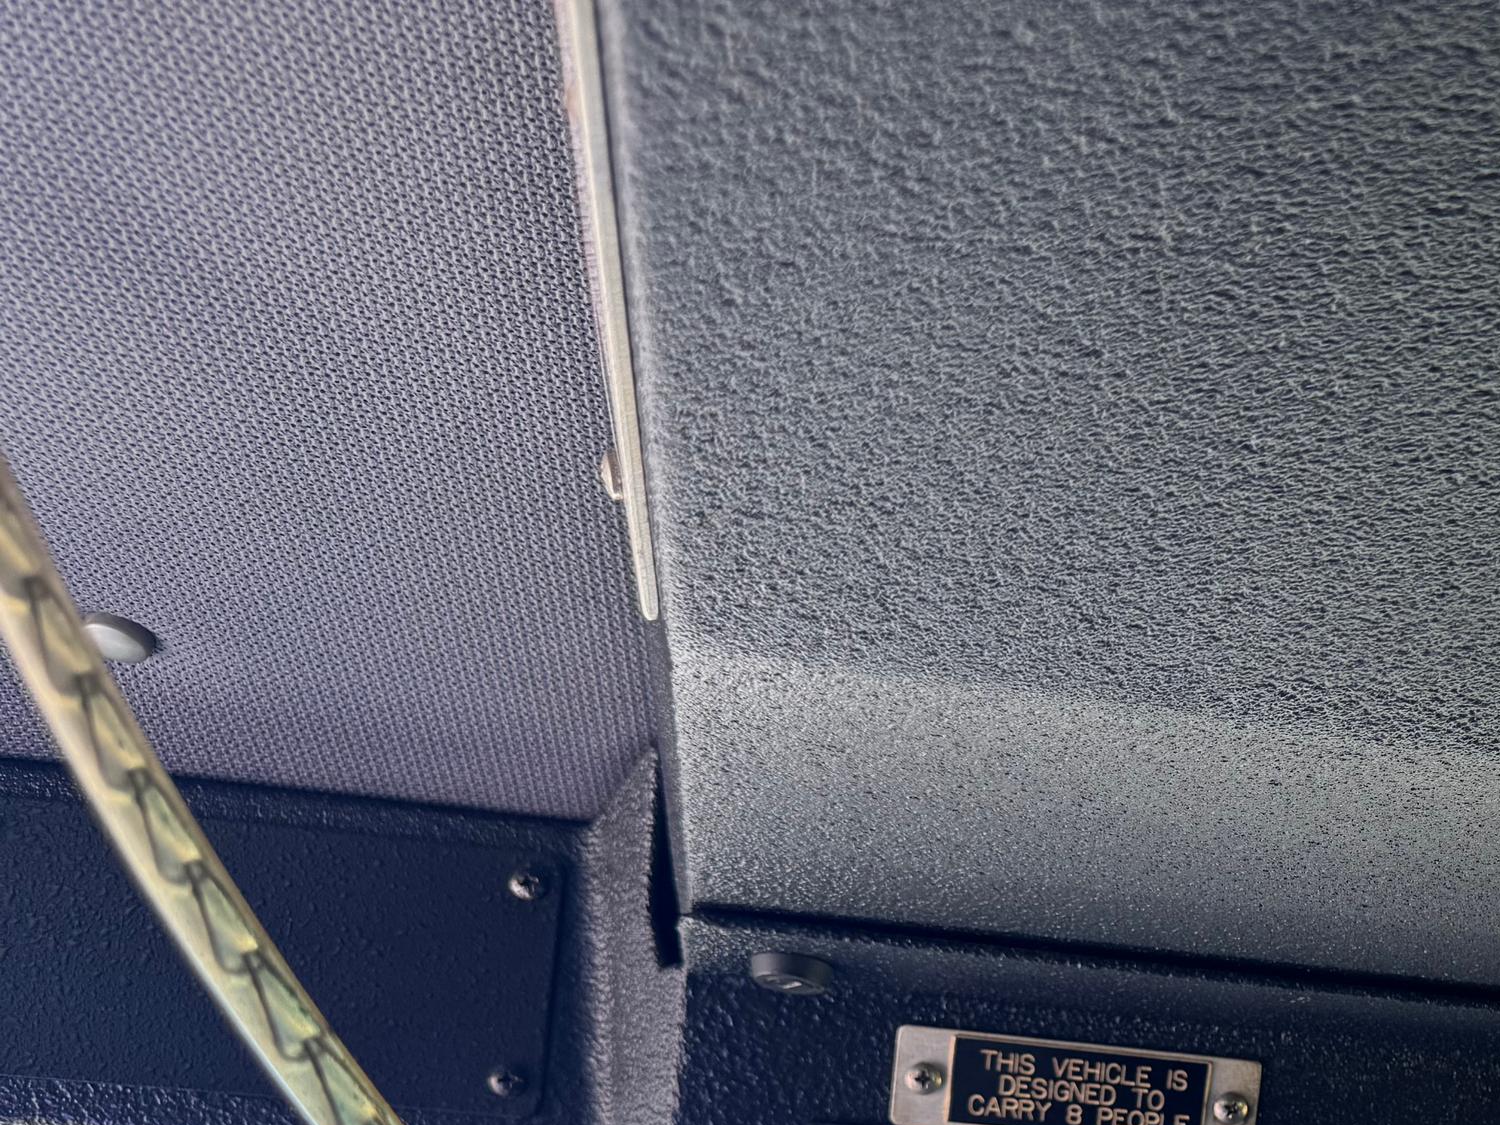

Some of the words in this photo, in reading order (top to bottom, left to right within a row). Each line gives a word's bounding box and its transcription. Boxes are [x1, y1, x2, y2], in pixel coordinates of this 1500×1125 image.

[980, 1049, 1036, 1075] THIS
[1052, 1057, 1152, 1088] VEHICLE
[1166, 1069, 1189, 1091] IS
[968, 1094, 1052, 1122] CARRY
[1065, 1105, 1083, 1125] 8
[1000, 1075, 1117, 1107] DESIGNED
[1132, 1087, 1165, 1111] TO
